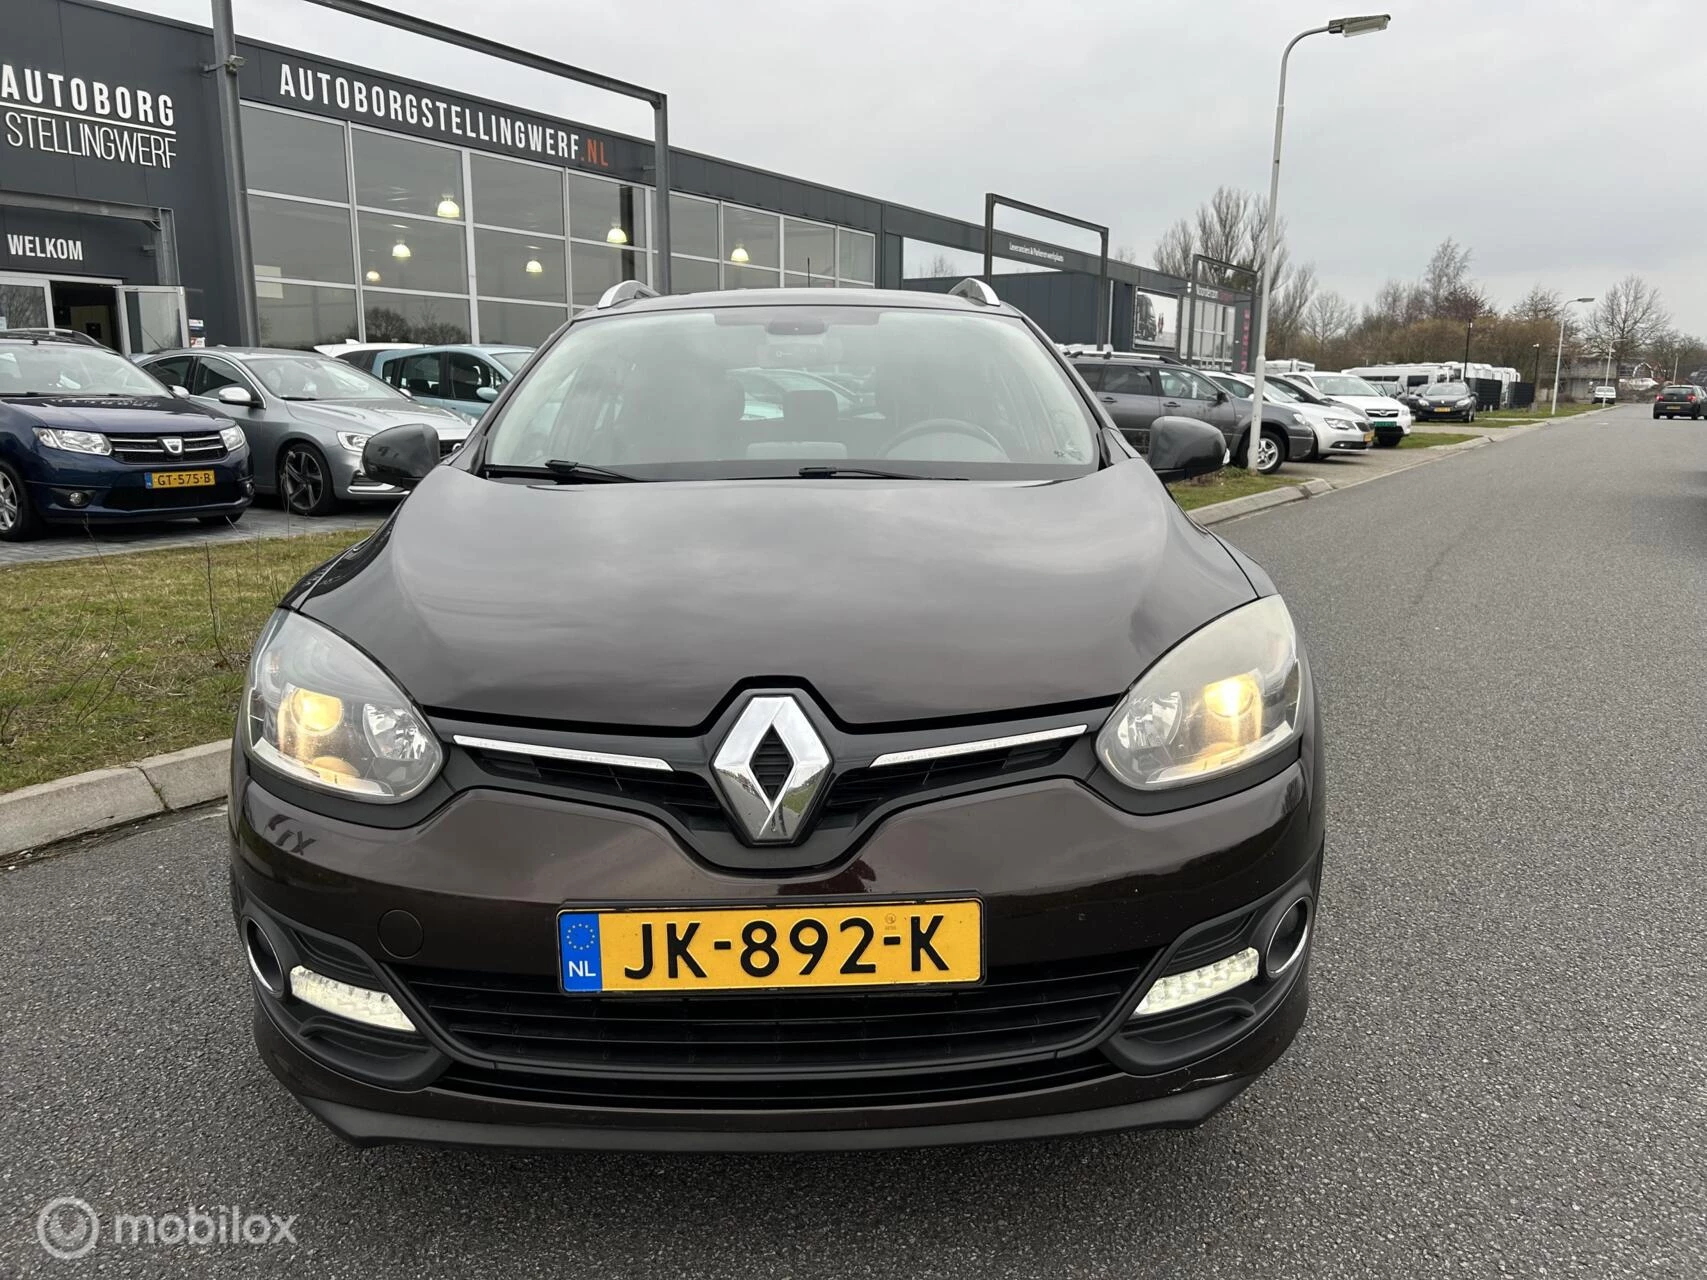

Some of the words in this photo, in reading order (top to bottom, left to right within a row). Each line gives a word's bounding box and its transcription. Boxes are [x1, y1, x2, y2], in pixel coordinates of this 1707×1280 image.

[1, 64, 175, 126] AUTOBORG
[279, 63, 609, 167] AUTOBORGSTELLINGWERF.NL
[5, 111, 176, 169] STELLINGWERF
[7, 233, 83, 261] WELKOM
[157, 472, 211, 486] GT-575-B
[568, 961, 597, 978] NL
[623, 914, 951, 980] JK-892-K
